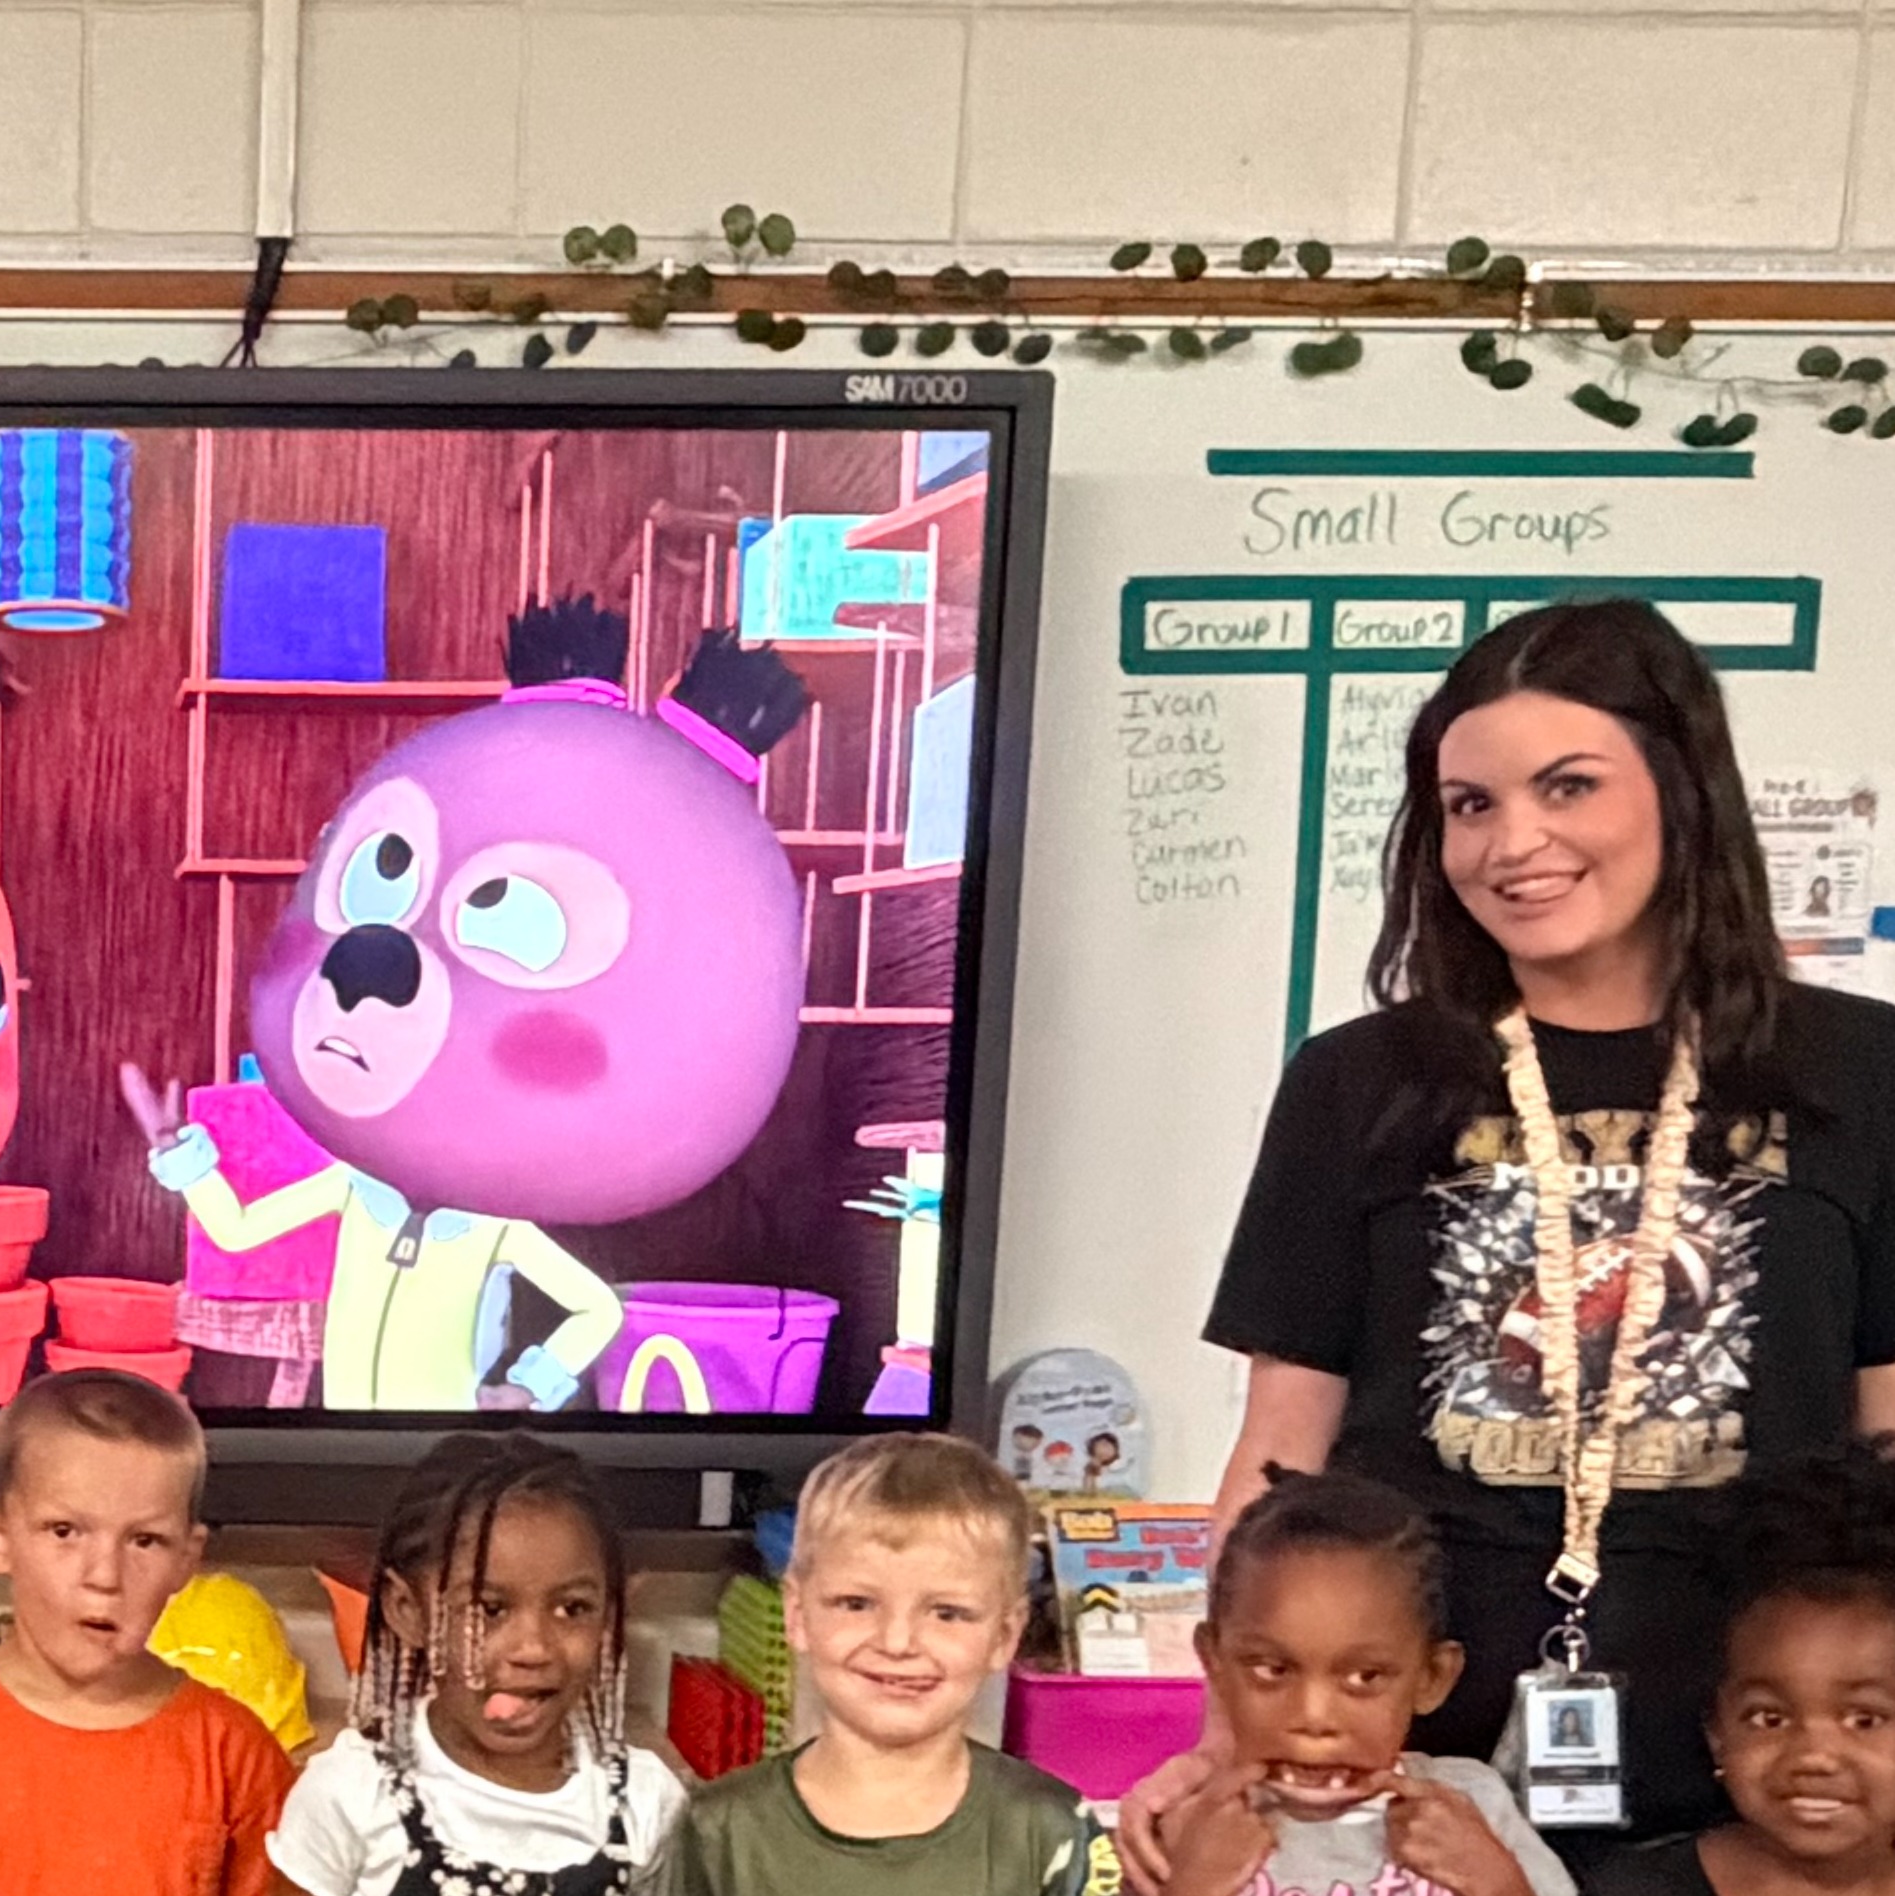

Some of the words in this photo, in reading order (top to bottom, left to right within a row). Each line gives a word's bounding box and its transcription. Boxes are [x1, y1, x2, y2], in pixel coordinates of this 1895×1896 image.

[1244, 487, 1396, 556] Small
[1441, 490, 1611, 556] Groups
[1154, 608, 1270, 647] Group
[1280, 609, 1291, 643] 1
[1336, 609, 1426, 646] Group
[1432, 612, 1454, 643] 2
[1118, 689, 1218, 719] Ivan
[1117, 722, 1225, 759] Zade
[1128, 763, 1227, 800] Lucas
